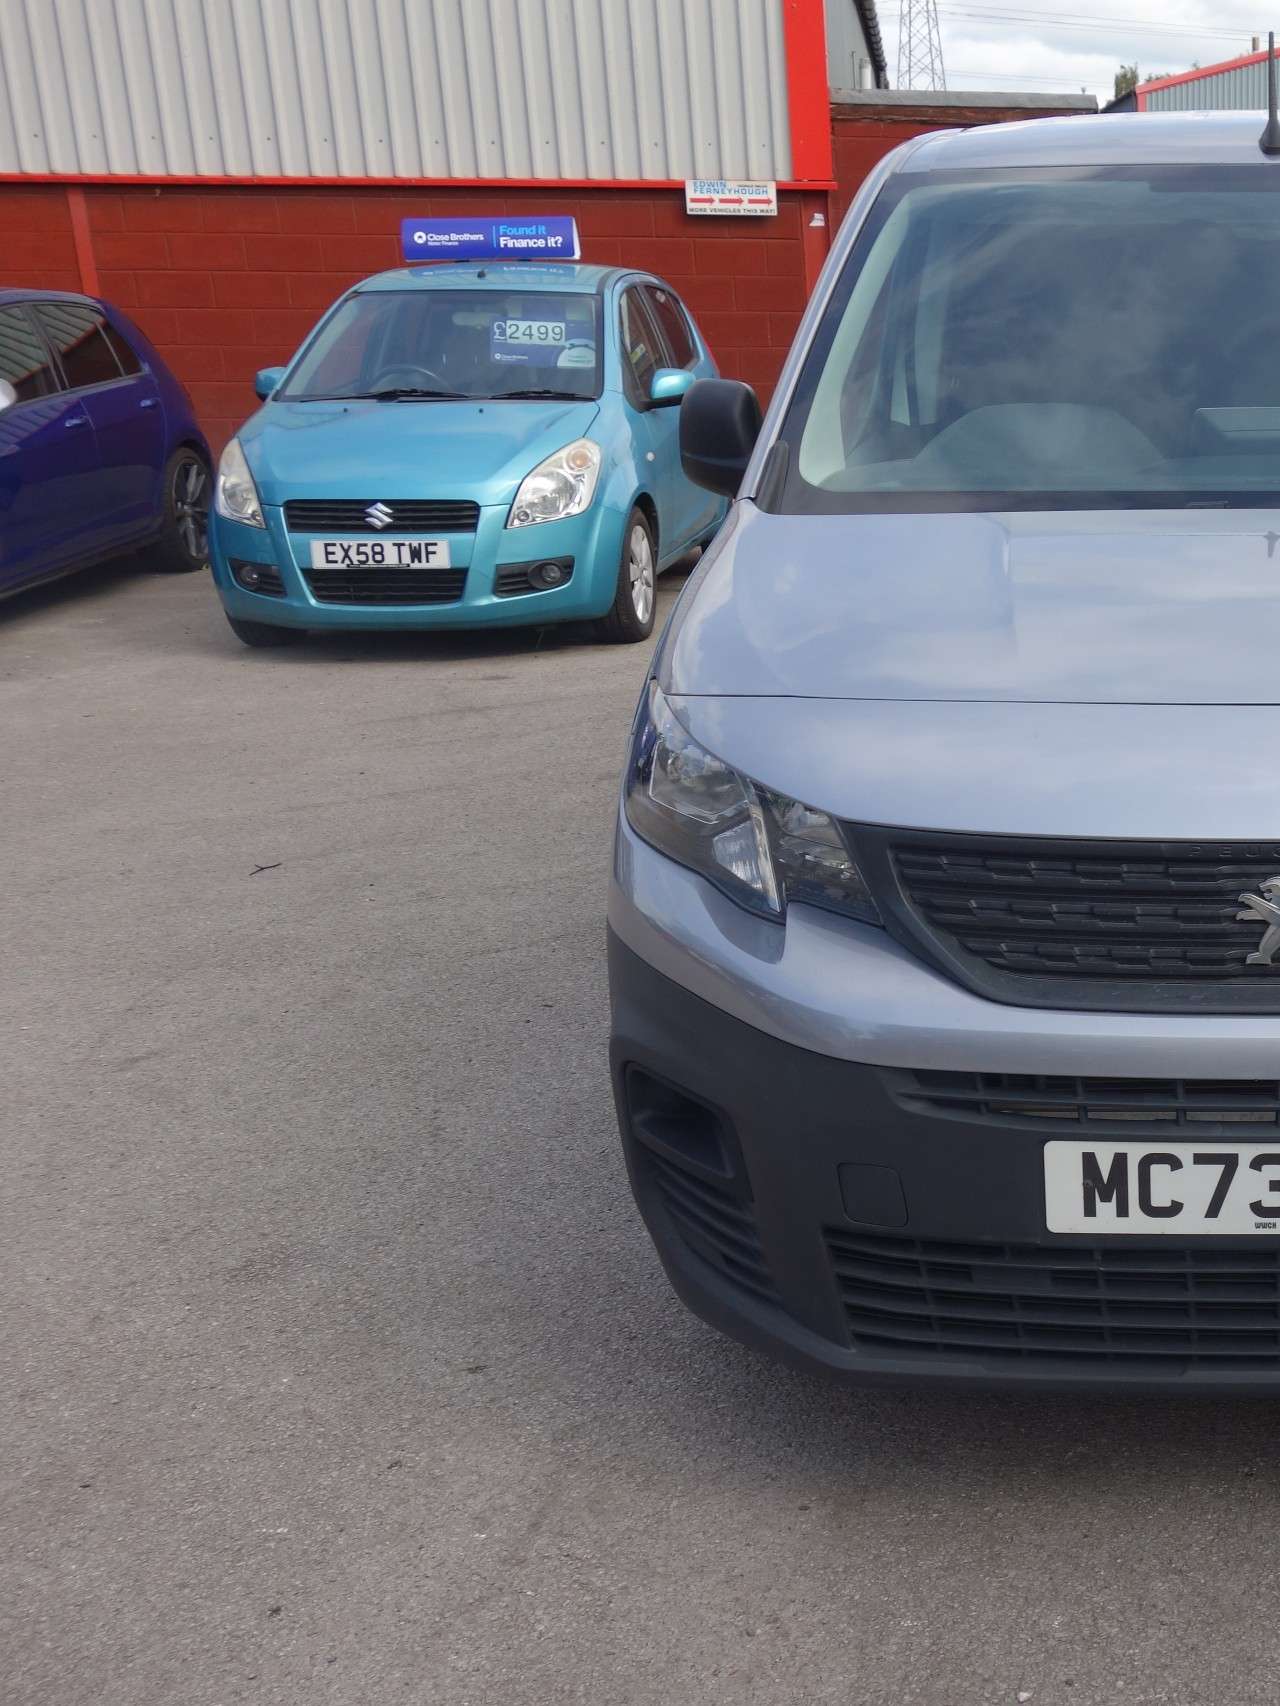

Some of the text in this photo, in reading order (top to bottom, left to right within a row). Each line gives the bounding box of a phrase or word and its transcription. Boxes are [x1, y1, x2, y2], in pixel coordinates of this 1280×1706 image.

[693, 187, 769, 195] FERNEYHOUGH
[499, 225, 536, 235] Found
[427, 232, 485, 242] Close Brothers
[500, 236, 563, 248] Finance it?
[323, 542, 438, 564] EX58 TWF
